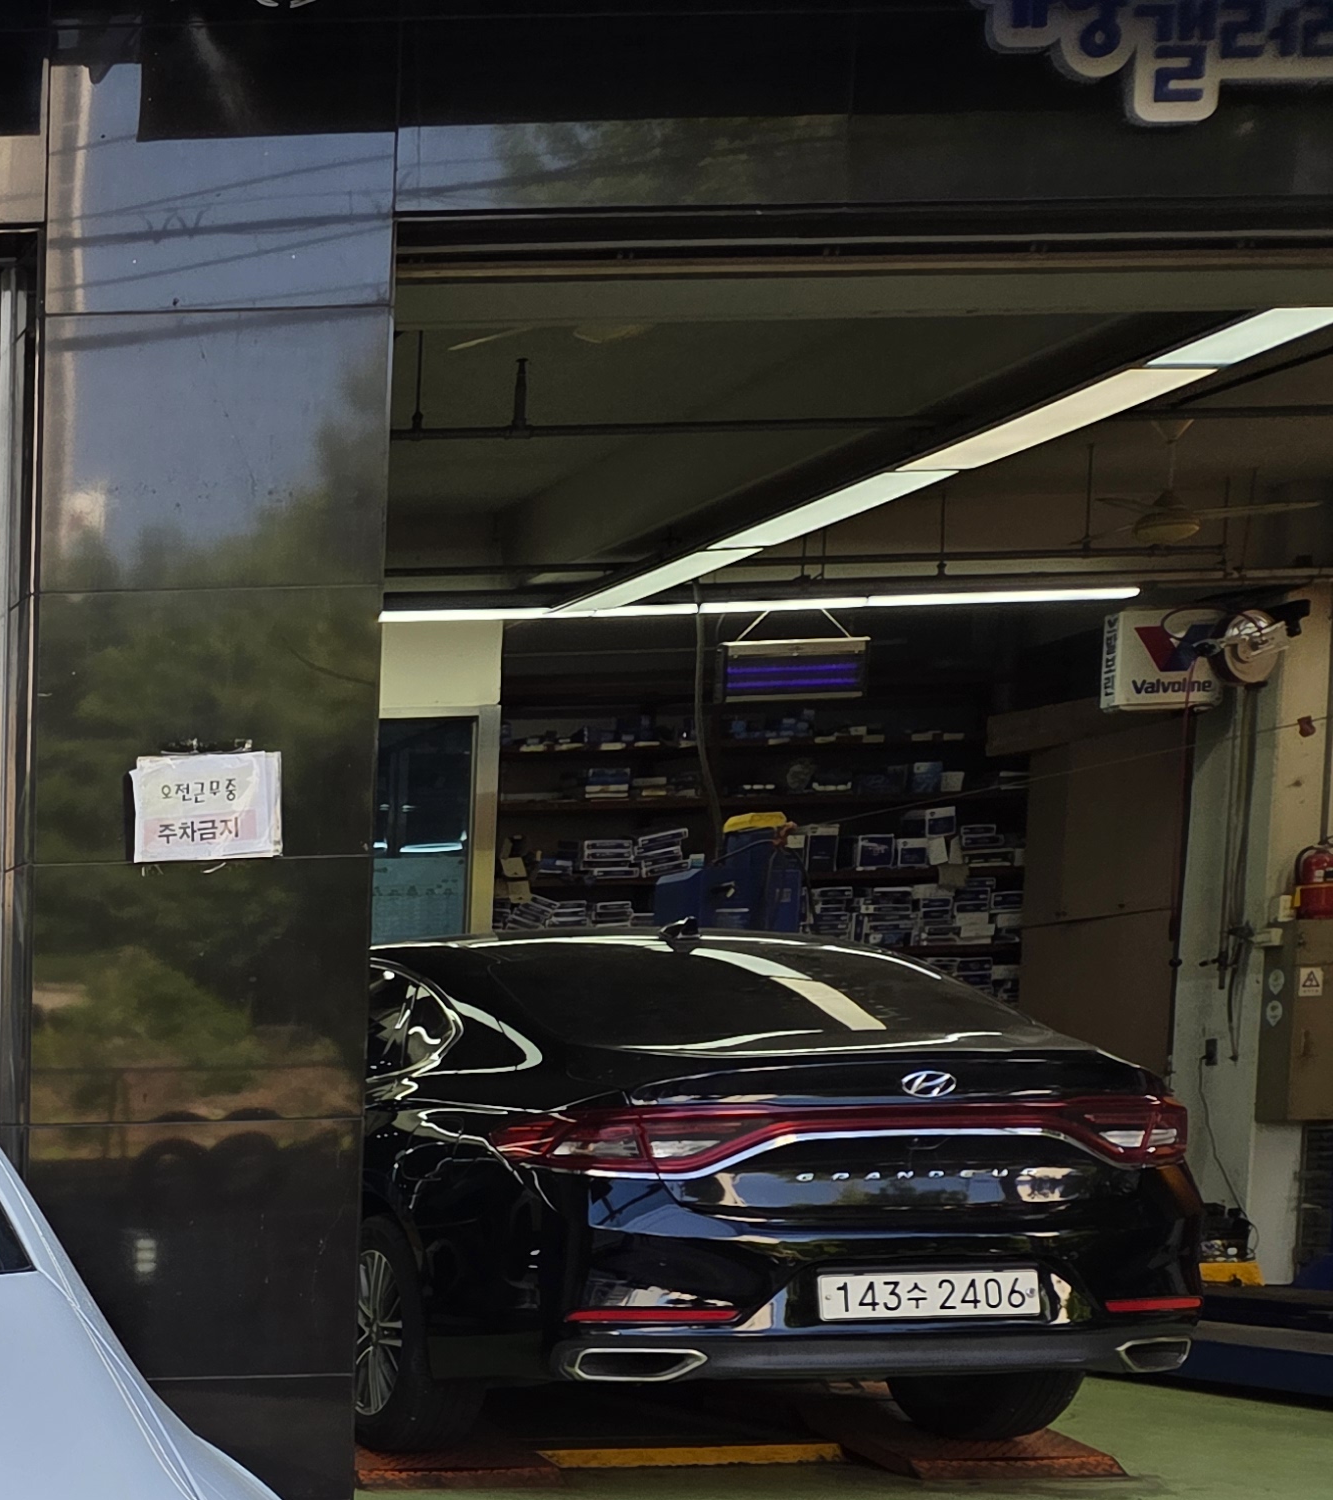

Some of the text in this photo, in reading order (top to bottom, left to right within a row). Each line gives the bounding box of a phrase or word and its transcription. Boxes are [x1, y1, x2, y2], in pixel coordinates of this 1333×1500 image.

[1132, 677, 1213, 694] Valvolne
[157, 816, 240, 844] 주차금지
[836, 1277, 1026, 1313] 143수 2406
